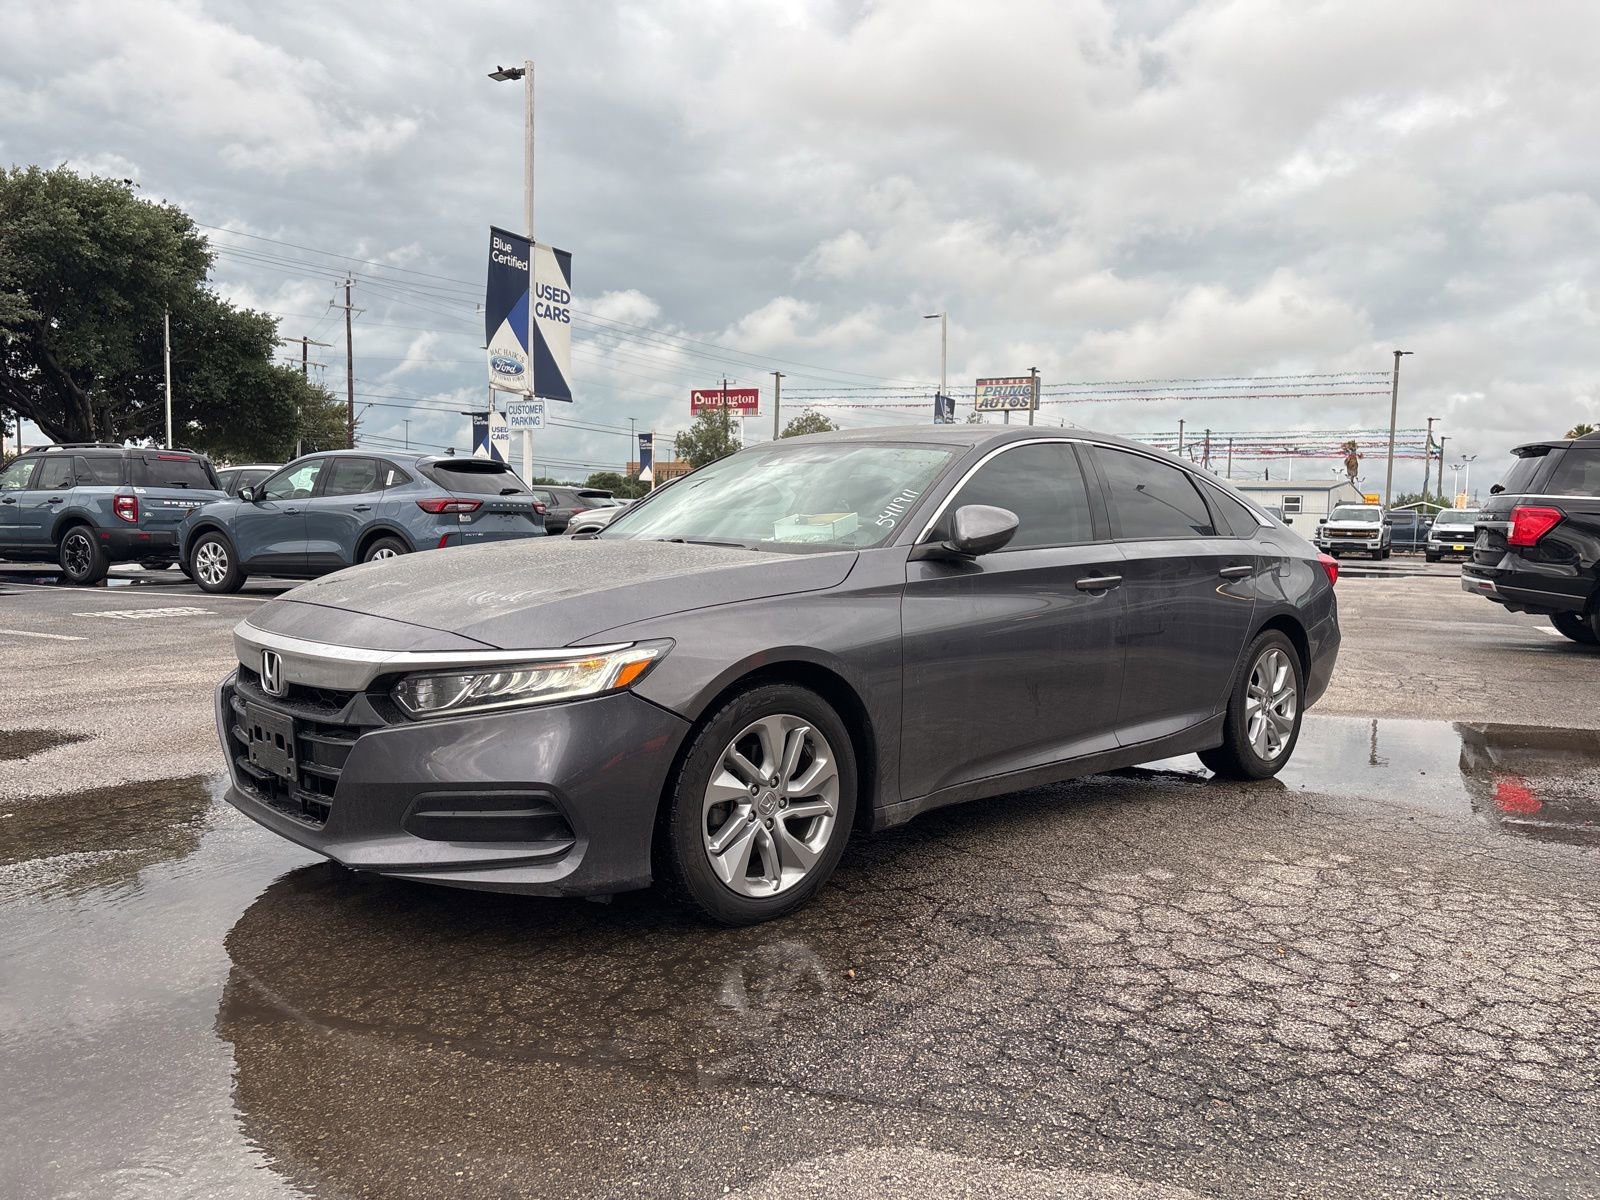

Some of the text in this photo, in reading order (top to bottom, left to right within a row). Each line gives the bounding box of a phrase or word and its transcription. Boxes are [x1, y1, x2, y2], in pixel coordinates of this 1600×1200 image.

[492, 237, 512, 253] Blue
[491, 250, 528, 271] Certified
[535, 282, 570, 305] USED
[535, 302, 570, 324] CARS
[495, 358, 517, 374] Ford
[982, 385, 1032, 396] PRIMO
[694, 391, 755, 408] Burlington
[978, 397, 1029, 408] AUTOS
[509, 405, 543, 415] CUSTOMER
[511, 416, 540, 426] PARKING
